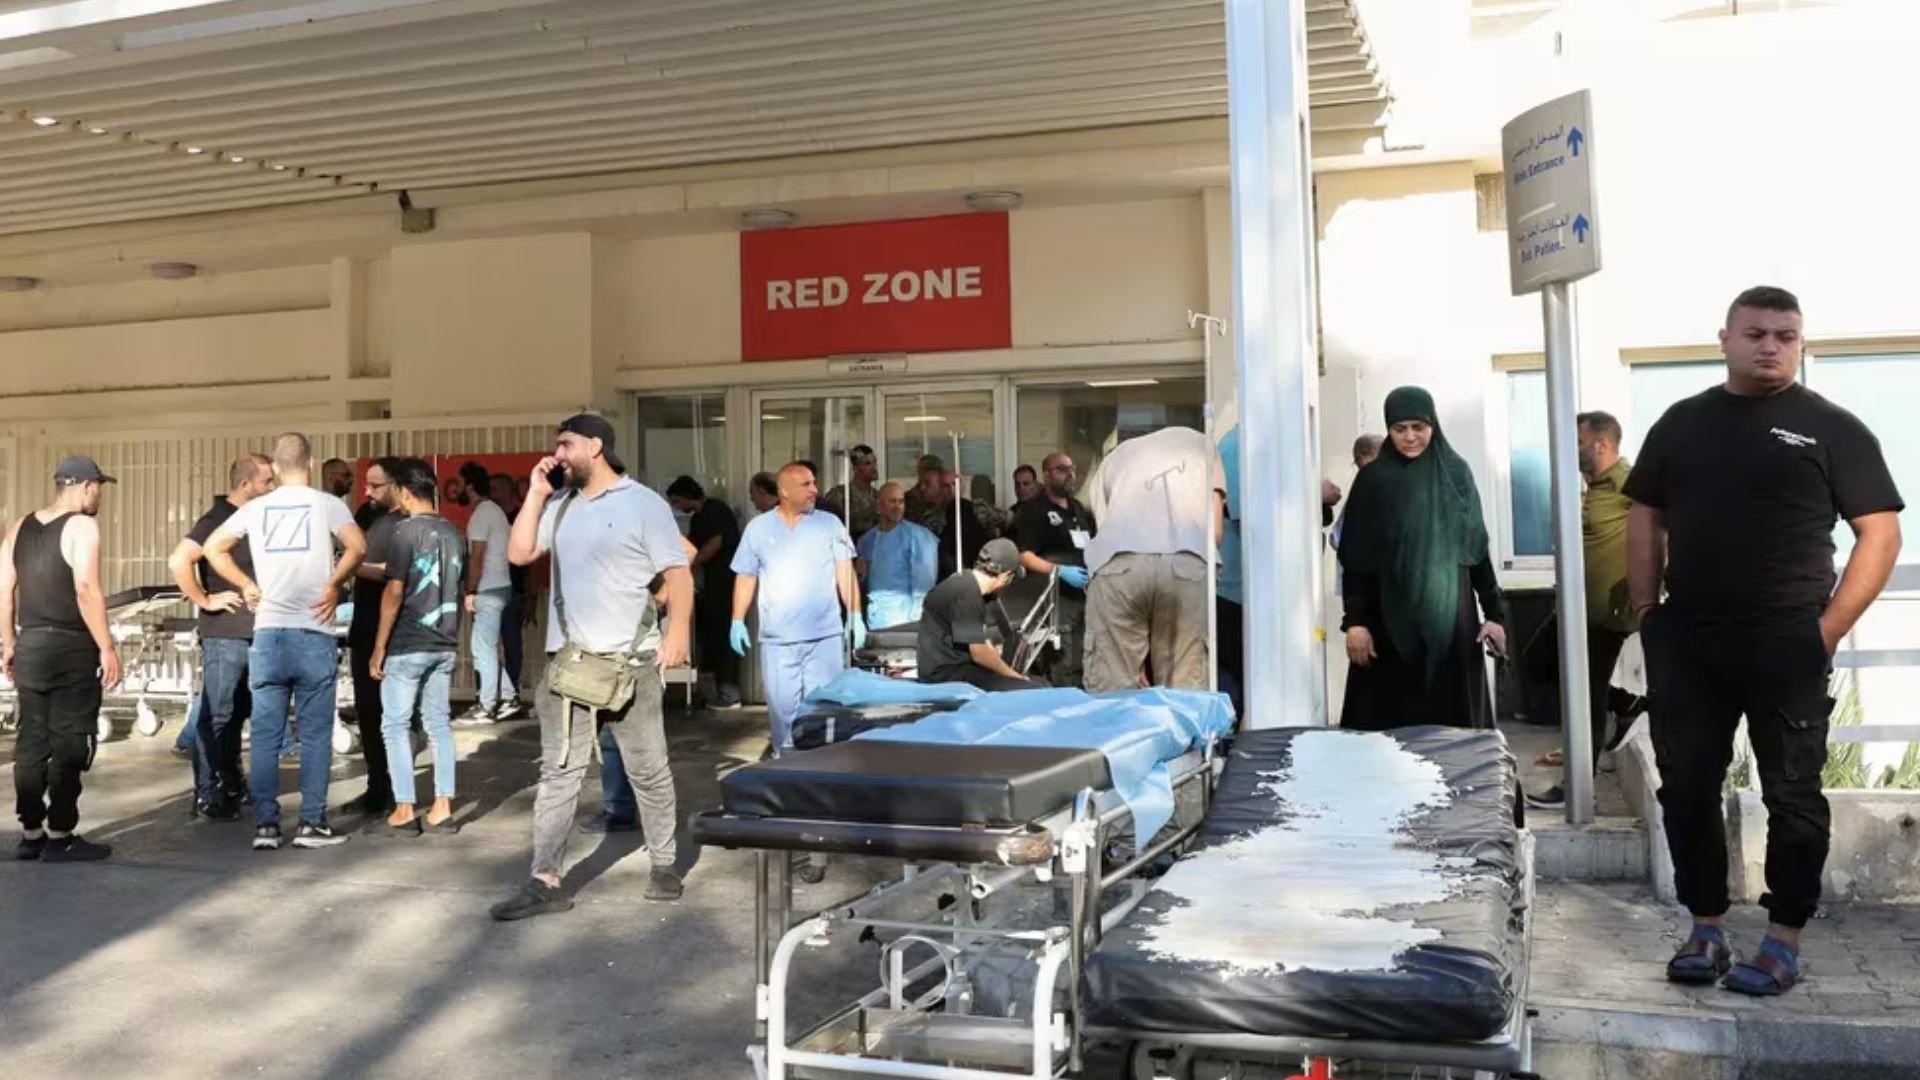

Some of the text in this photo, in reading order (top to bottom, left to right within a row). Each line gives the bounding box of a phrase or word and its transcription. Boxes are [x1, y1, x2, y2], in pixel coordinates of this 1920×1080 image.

[1528, 155, 1565, 177] Entrance
[766, 265, 983, 310] RED ZONE
